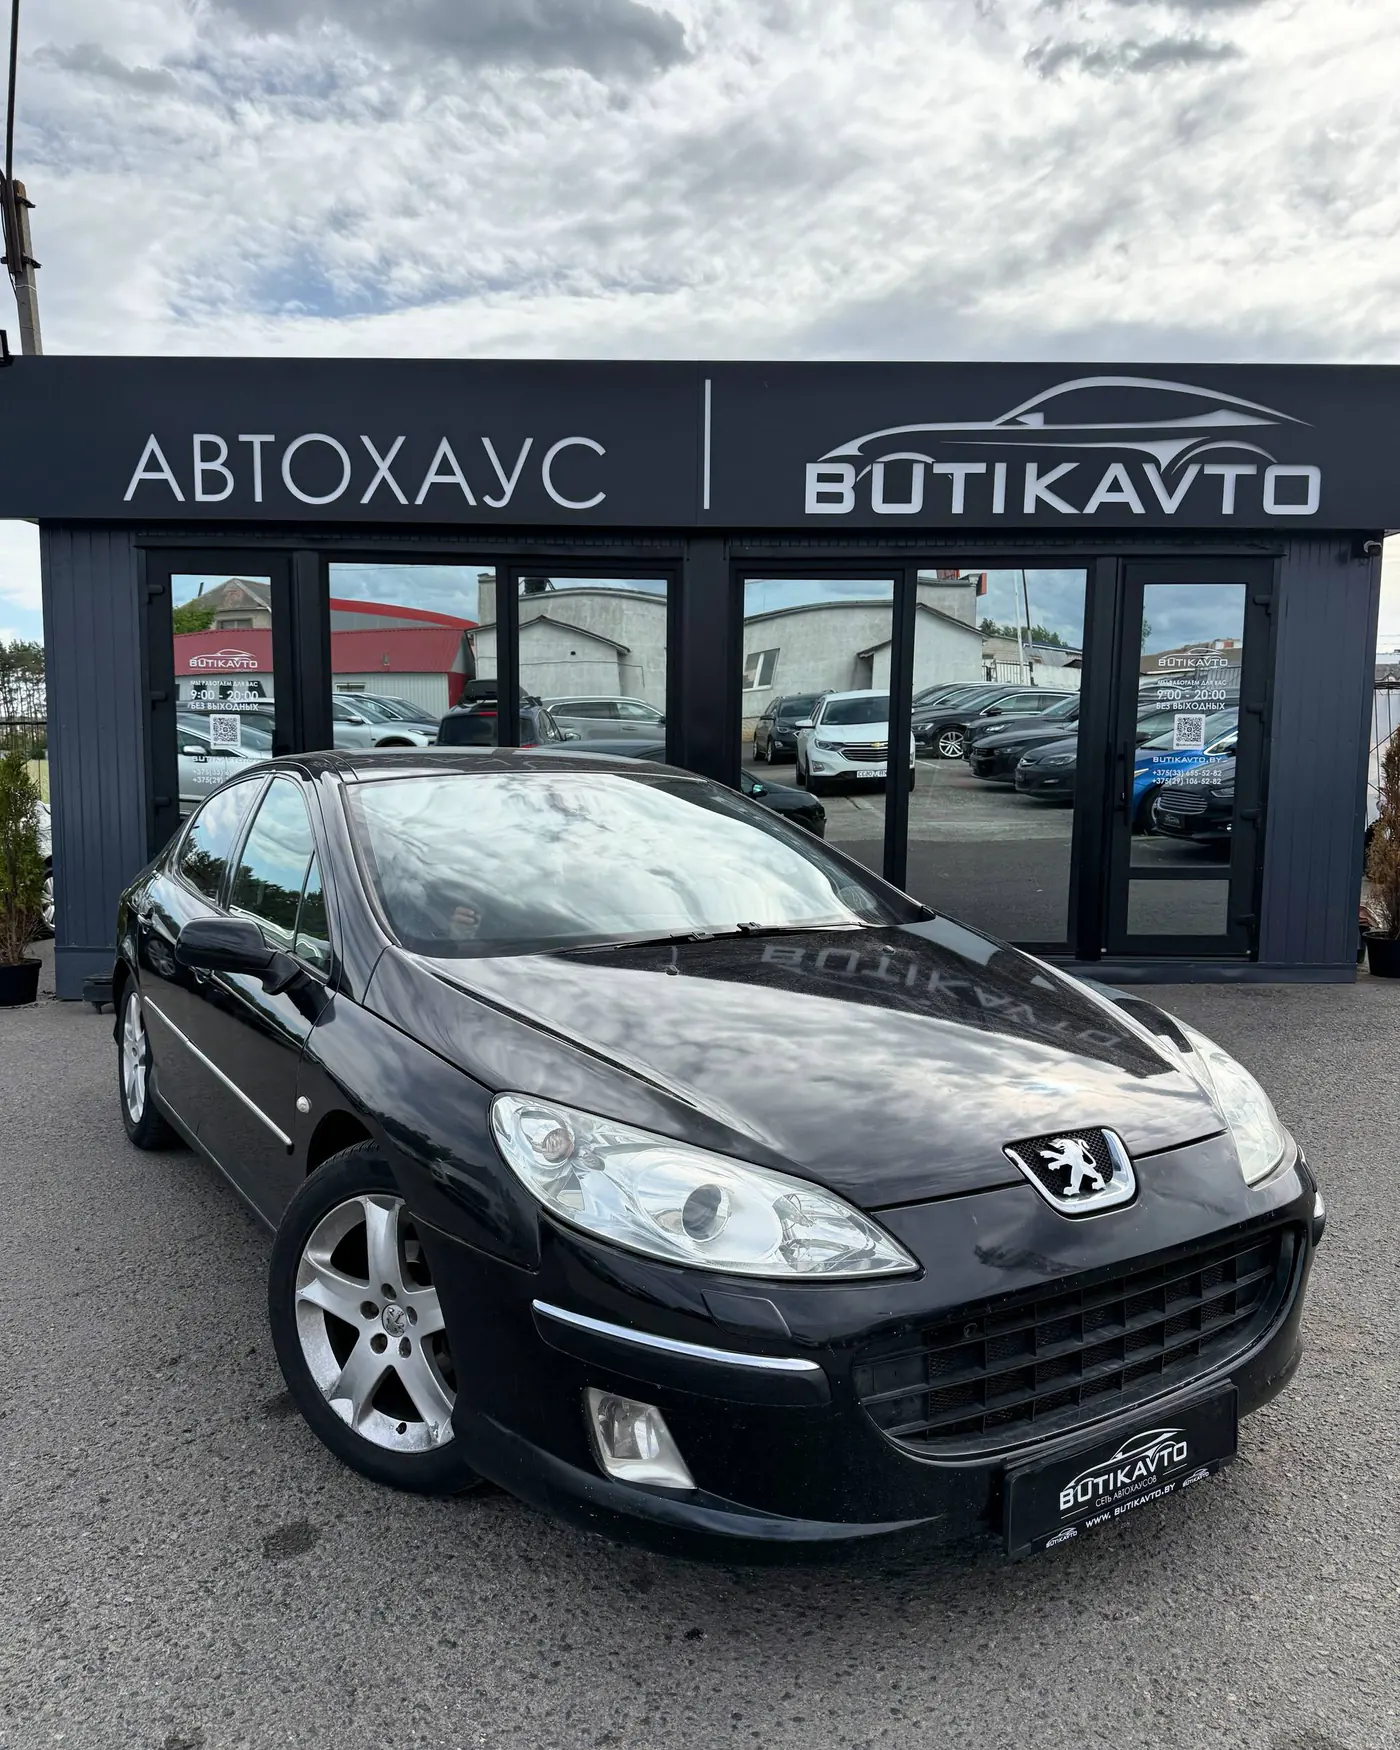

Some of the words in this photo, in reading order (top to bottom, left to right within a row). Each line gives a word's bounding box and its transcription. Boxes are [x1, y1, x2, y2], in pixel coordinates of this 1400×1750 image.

[123, 433, 607, 509] АВТОХАУС
[804, 462, 1321, 515] BUTIKAVTO
[189, 658, 258, 668] BUTIKAVTO
[1158, 658, 1228, 667] BUTIKAVTO
[191, 689, 215, 700] 9:00
[226, 690, 259, 701] 20:00
[1157, 689, 1182, 700] 9:00
[1194, 689, 1226, 700] 20:00
[207, 703, 259, 711] ВЫХОДНЫХ
[1156, 702, 1171, 710] БЕЗ
[1173, 702, 1226, 711] ВЫХОДНЫХ
[1152, 769, 1184, 777] +375(33)
[1152, 777, 1184, 785] +375(29)
[1186, 777, 1222, 785] 106-52-82
[1059, 1441, 1188, 1511] BUTIKAVTO
[1095, 1494, 1113, 1508] СЕТЬ
[1113, 1474, 1157, 1502] АВТОХАУСОВ
[1114, 1482, 1176, 1516] BUTIKAVTO.BY
